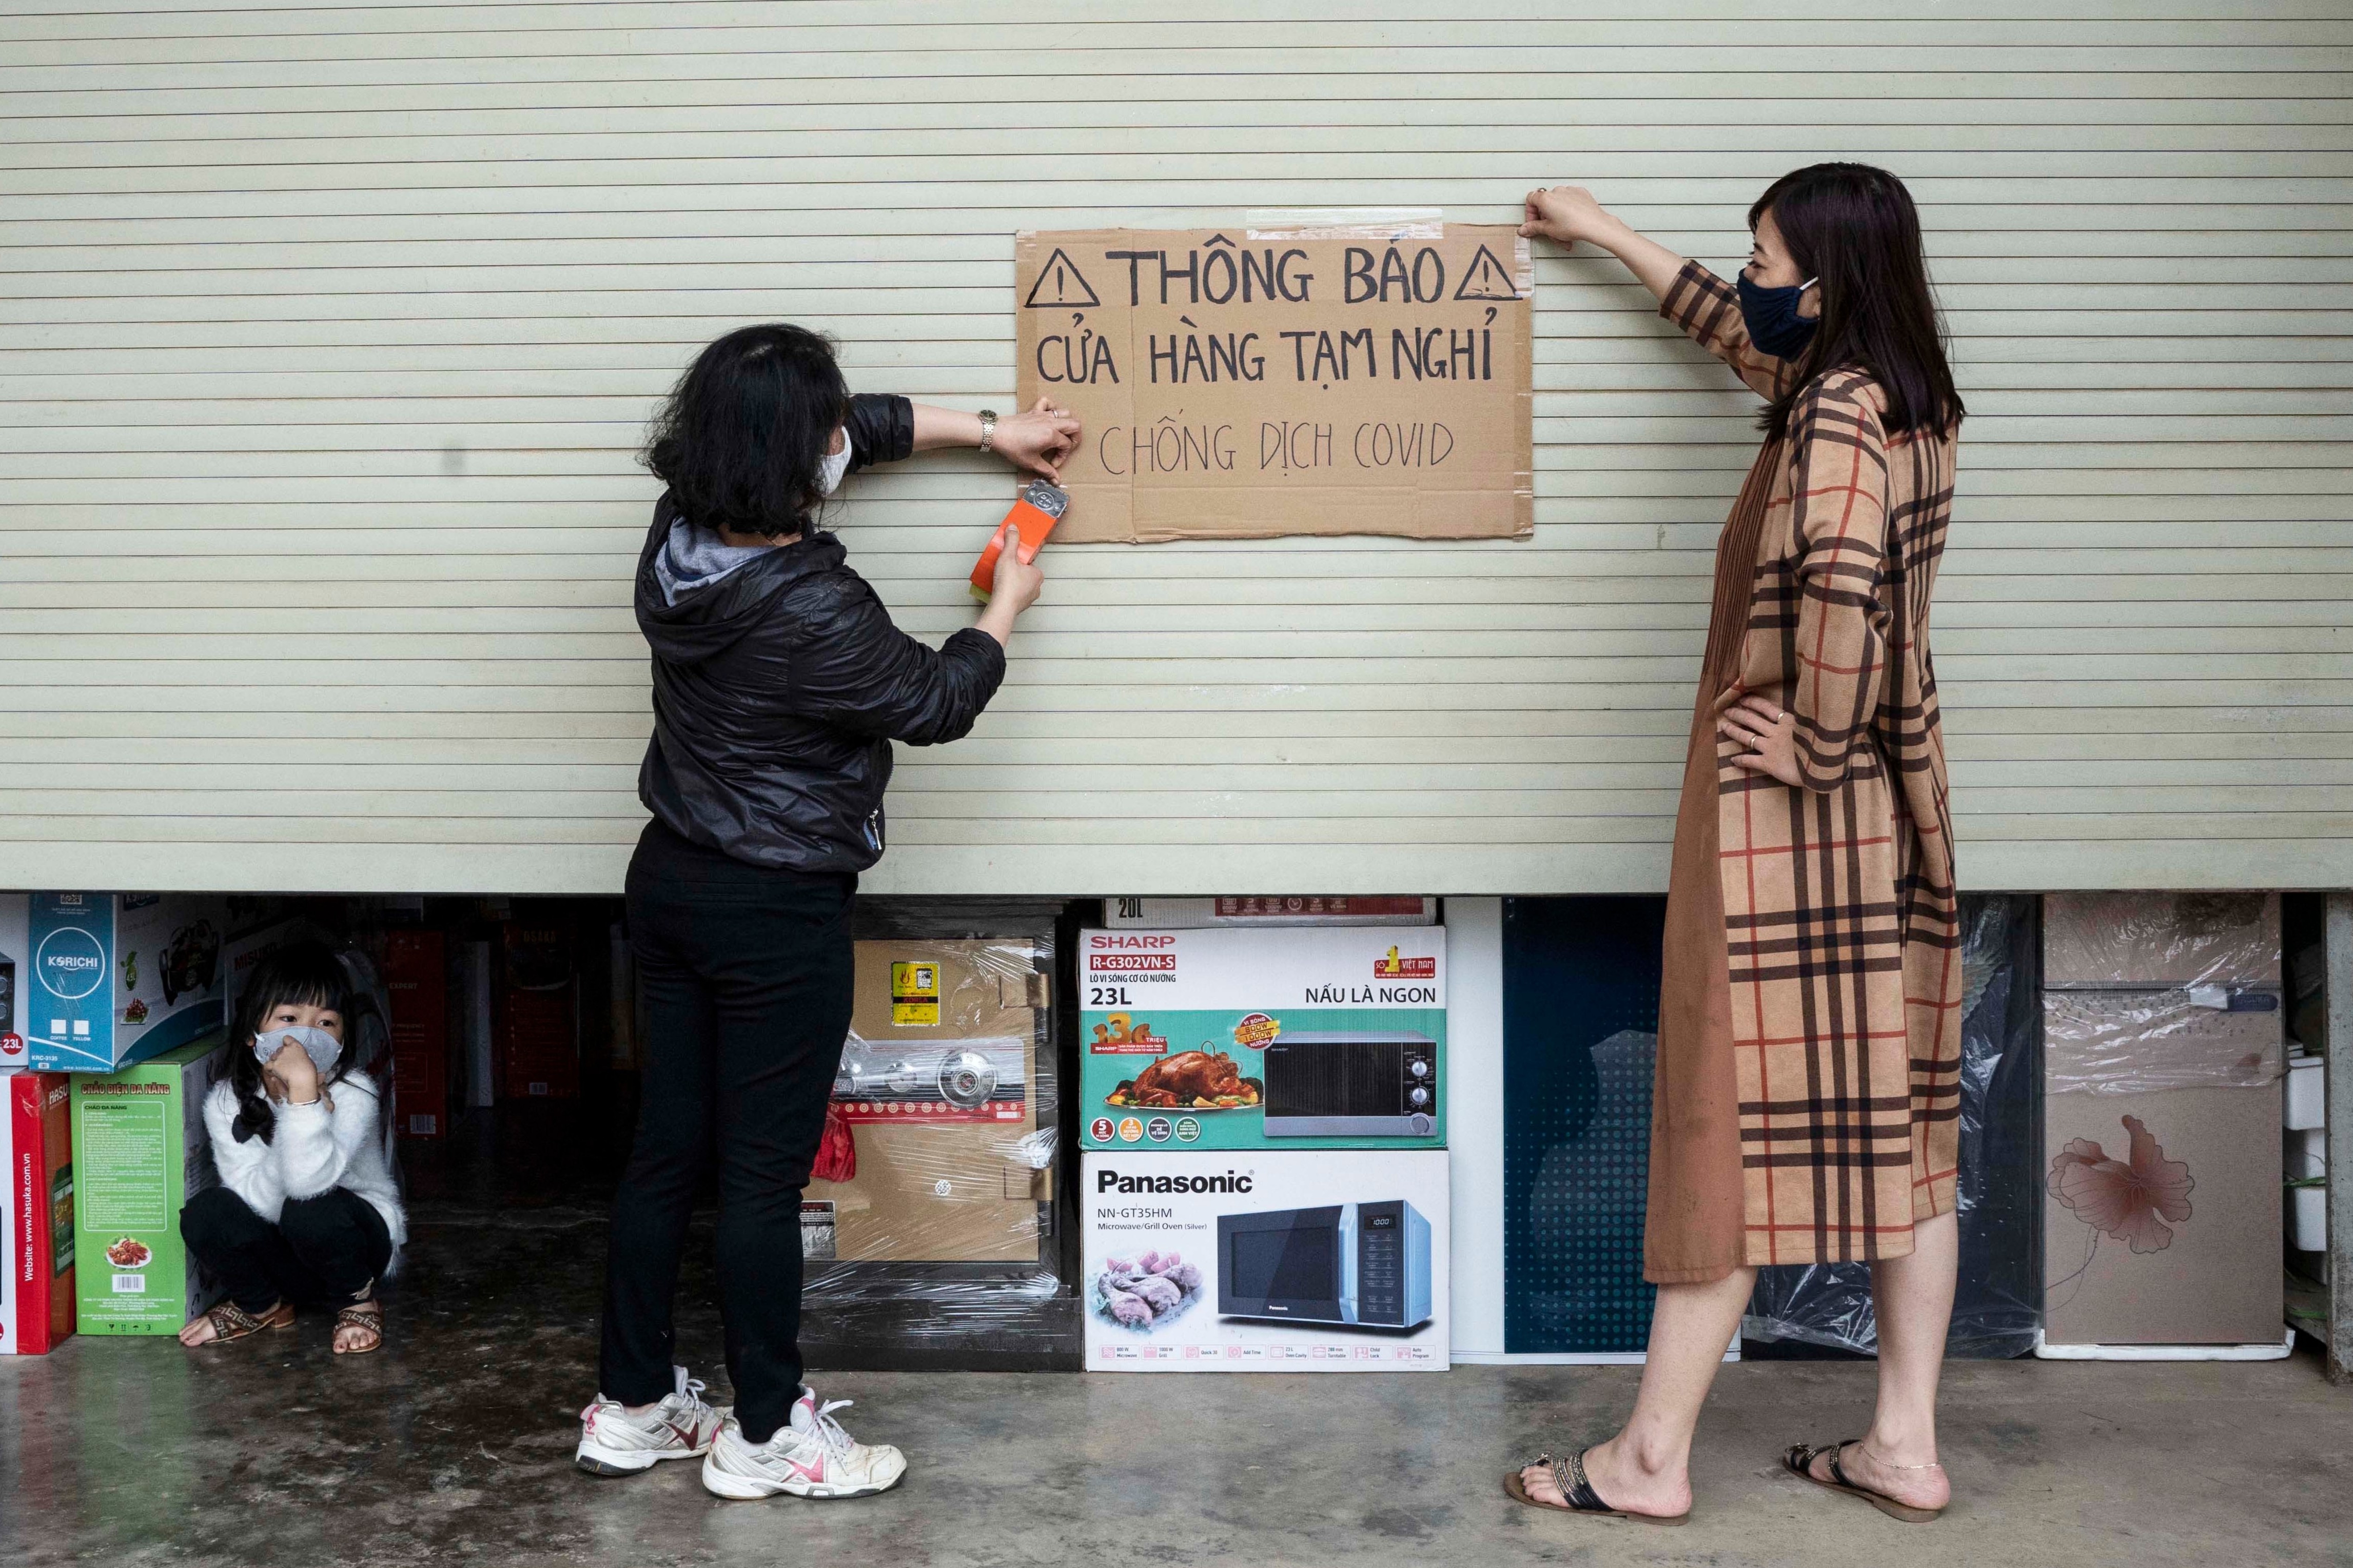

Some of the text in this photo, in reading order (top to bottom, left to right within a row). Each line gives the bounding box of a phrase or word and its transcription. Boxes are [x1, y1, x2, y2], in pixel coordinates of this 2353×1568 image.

[1106, 233, 1444, 306] THÔNG BÁO
[1037, 307, 1498, 390] CỬA HÀNG TẠM NGHỈ
[1100, 408, 1454, 477] CHỐNG DỊCH COVID
[1119, 898, 1143, 918] 20L
[1091, 936, 1175, 948] SHARP
[48, 956, 97, 968] KORICHI
[1093, 956, 1174, 968] R-G302VN-S
[1402, 959, 1416, 970] VIỆT
[1418, 960, 1433, 969] NAM
[1090, 973, 1099, 982] LÒ
[1108, 973, 1127, 982] SÓNG
[1140, 973, 1148, 982] CÓ
[1150, 972, 1176, 982] NƯỚNG
[1091, 987, 1132, 1005] 23L
[1305, 983, 1436, 1003] NẤU LÀ NGON
[1245, 1023, 1268, 1033] 800W
[1245, 1030, 1272, 1041] 1000W
[3, 1038, 22, 1048] 23L
[49, 1082, 70, 1105] HASU
[1099, 1120, 1107, 1131] 5
[1098, 1170, 1253, 1193] Panasonic
[23, 1153, 33, 1281] Website: www.hasuka.com.vn
[1098, 1208, 1172, 1218] NN-GT35HM
